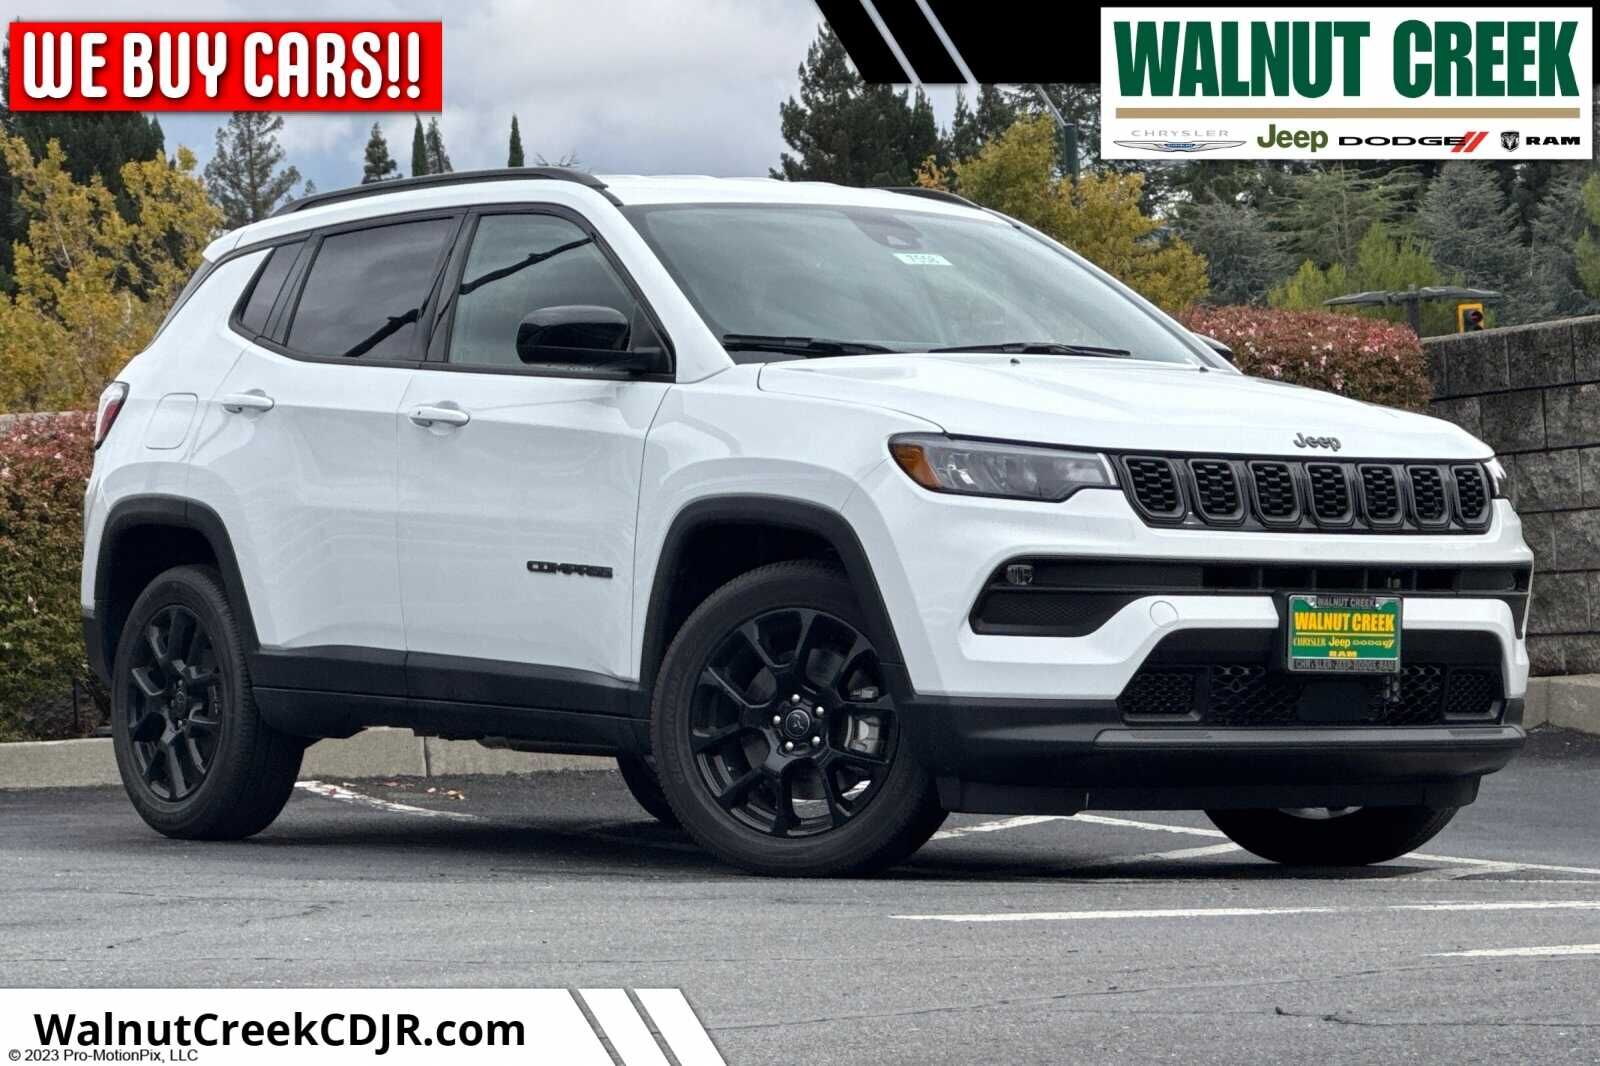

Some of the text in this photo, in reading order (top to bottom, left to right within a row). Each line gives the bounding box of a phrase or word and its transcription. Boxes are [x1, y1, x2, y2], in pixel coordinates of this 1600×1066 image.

[1293, 432, 1342, 452] Jeep
[1317, 597, 1377, 609] WALNUT CREEK
[1294, 612, 1395, 632] WALNUT CREEK
[1328, 636, 1351, 649] Jeep
[1328, 650, 1357, 658] RAM
